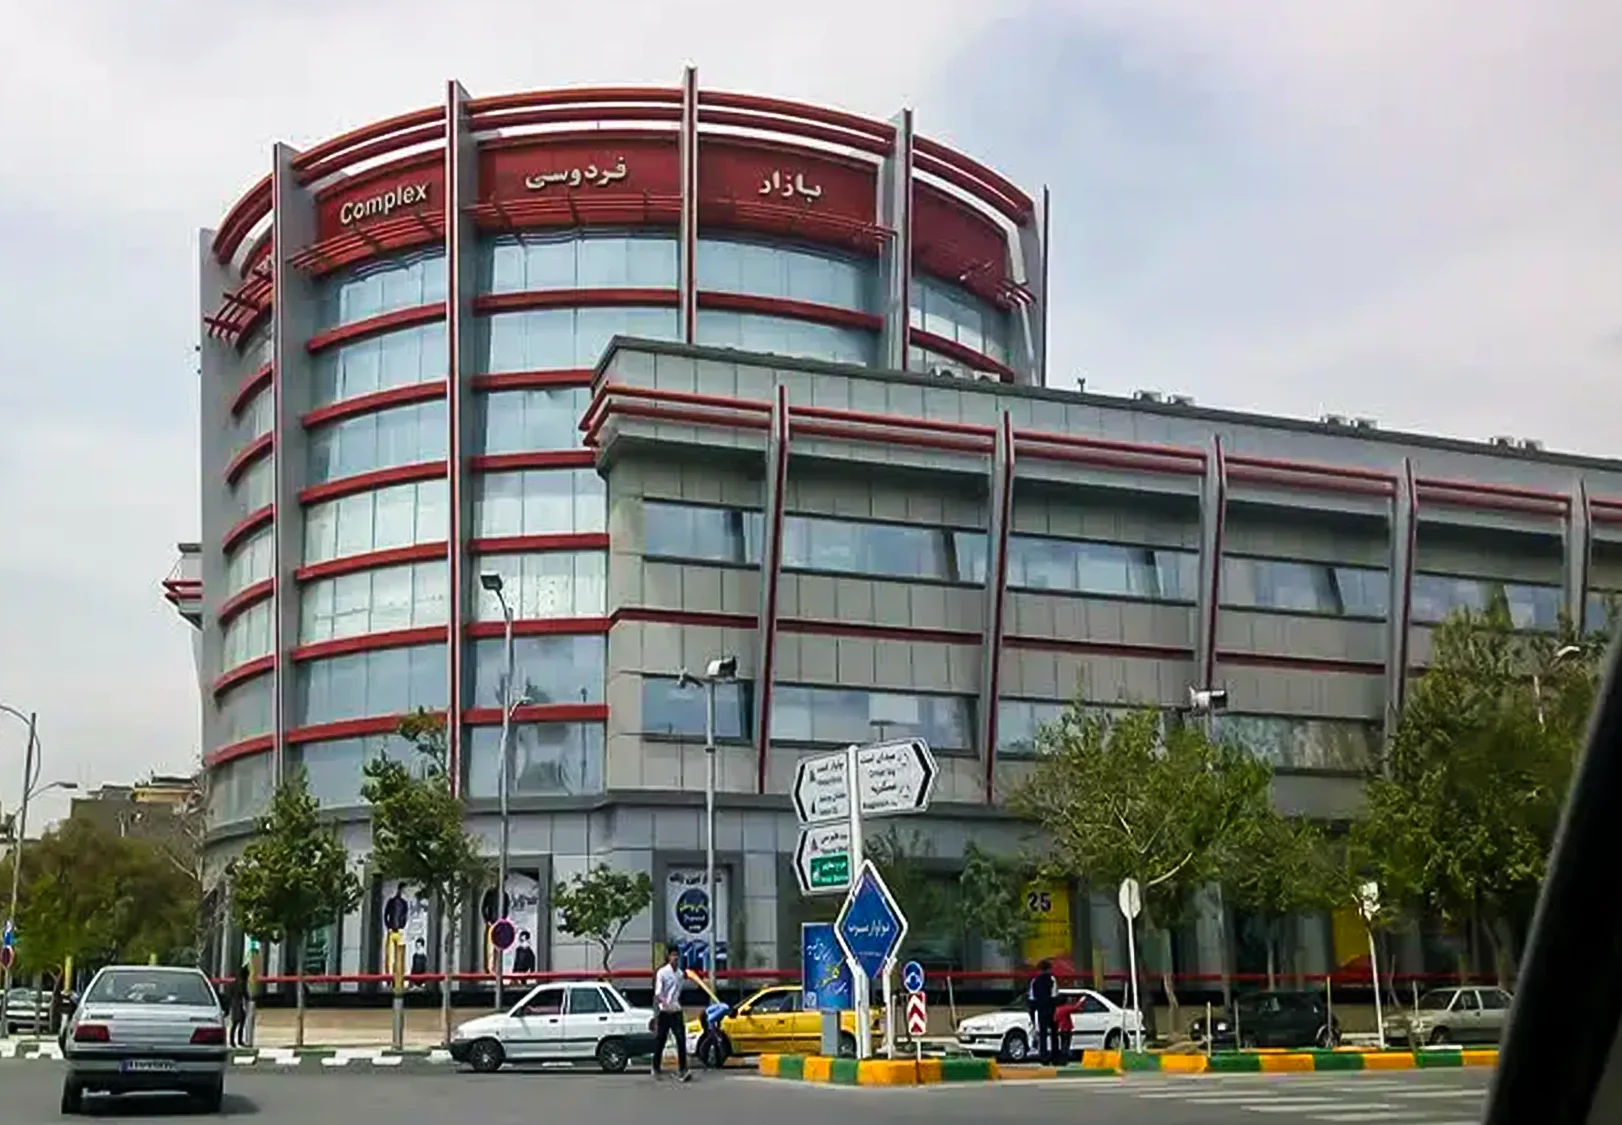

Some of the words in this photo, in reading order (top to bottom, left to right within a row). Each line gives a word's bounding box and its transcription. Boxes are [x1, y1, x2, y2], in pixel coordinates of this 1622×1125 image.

[525, 156, 627, 189] فردوسی
[758, 170, 822, 202] بازار
[340, 184, 428, 221] Complex
[1027, 891, 1053, 912] 25
